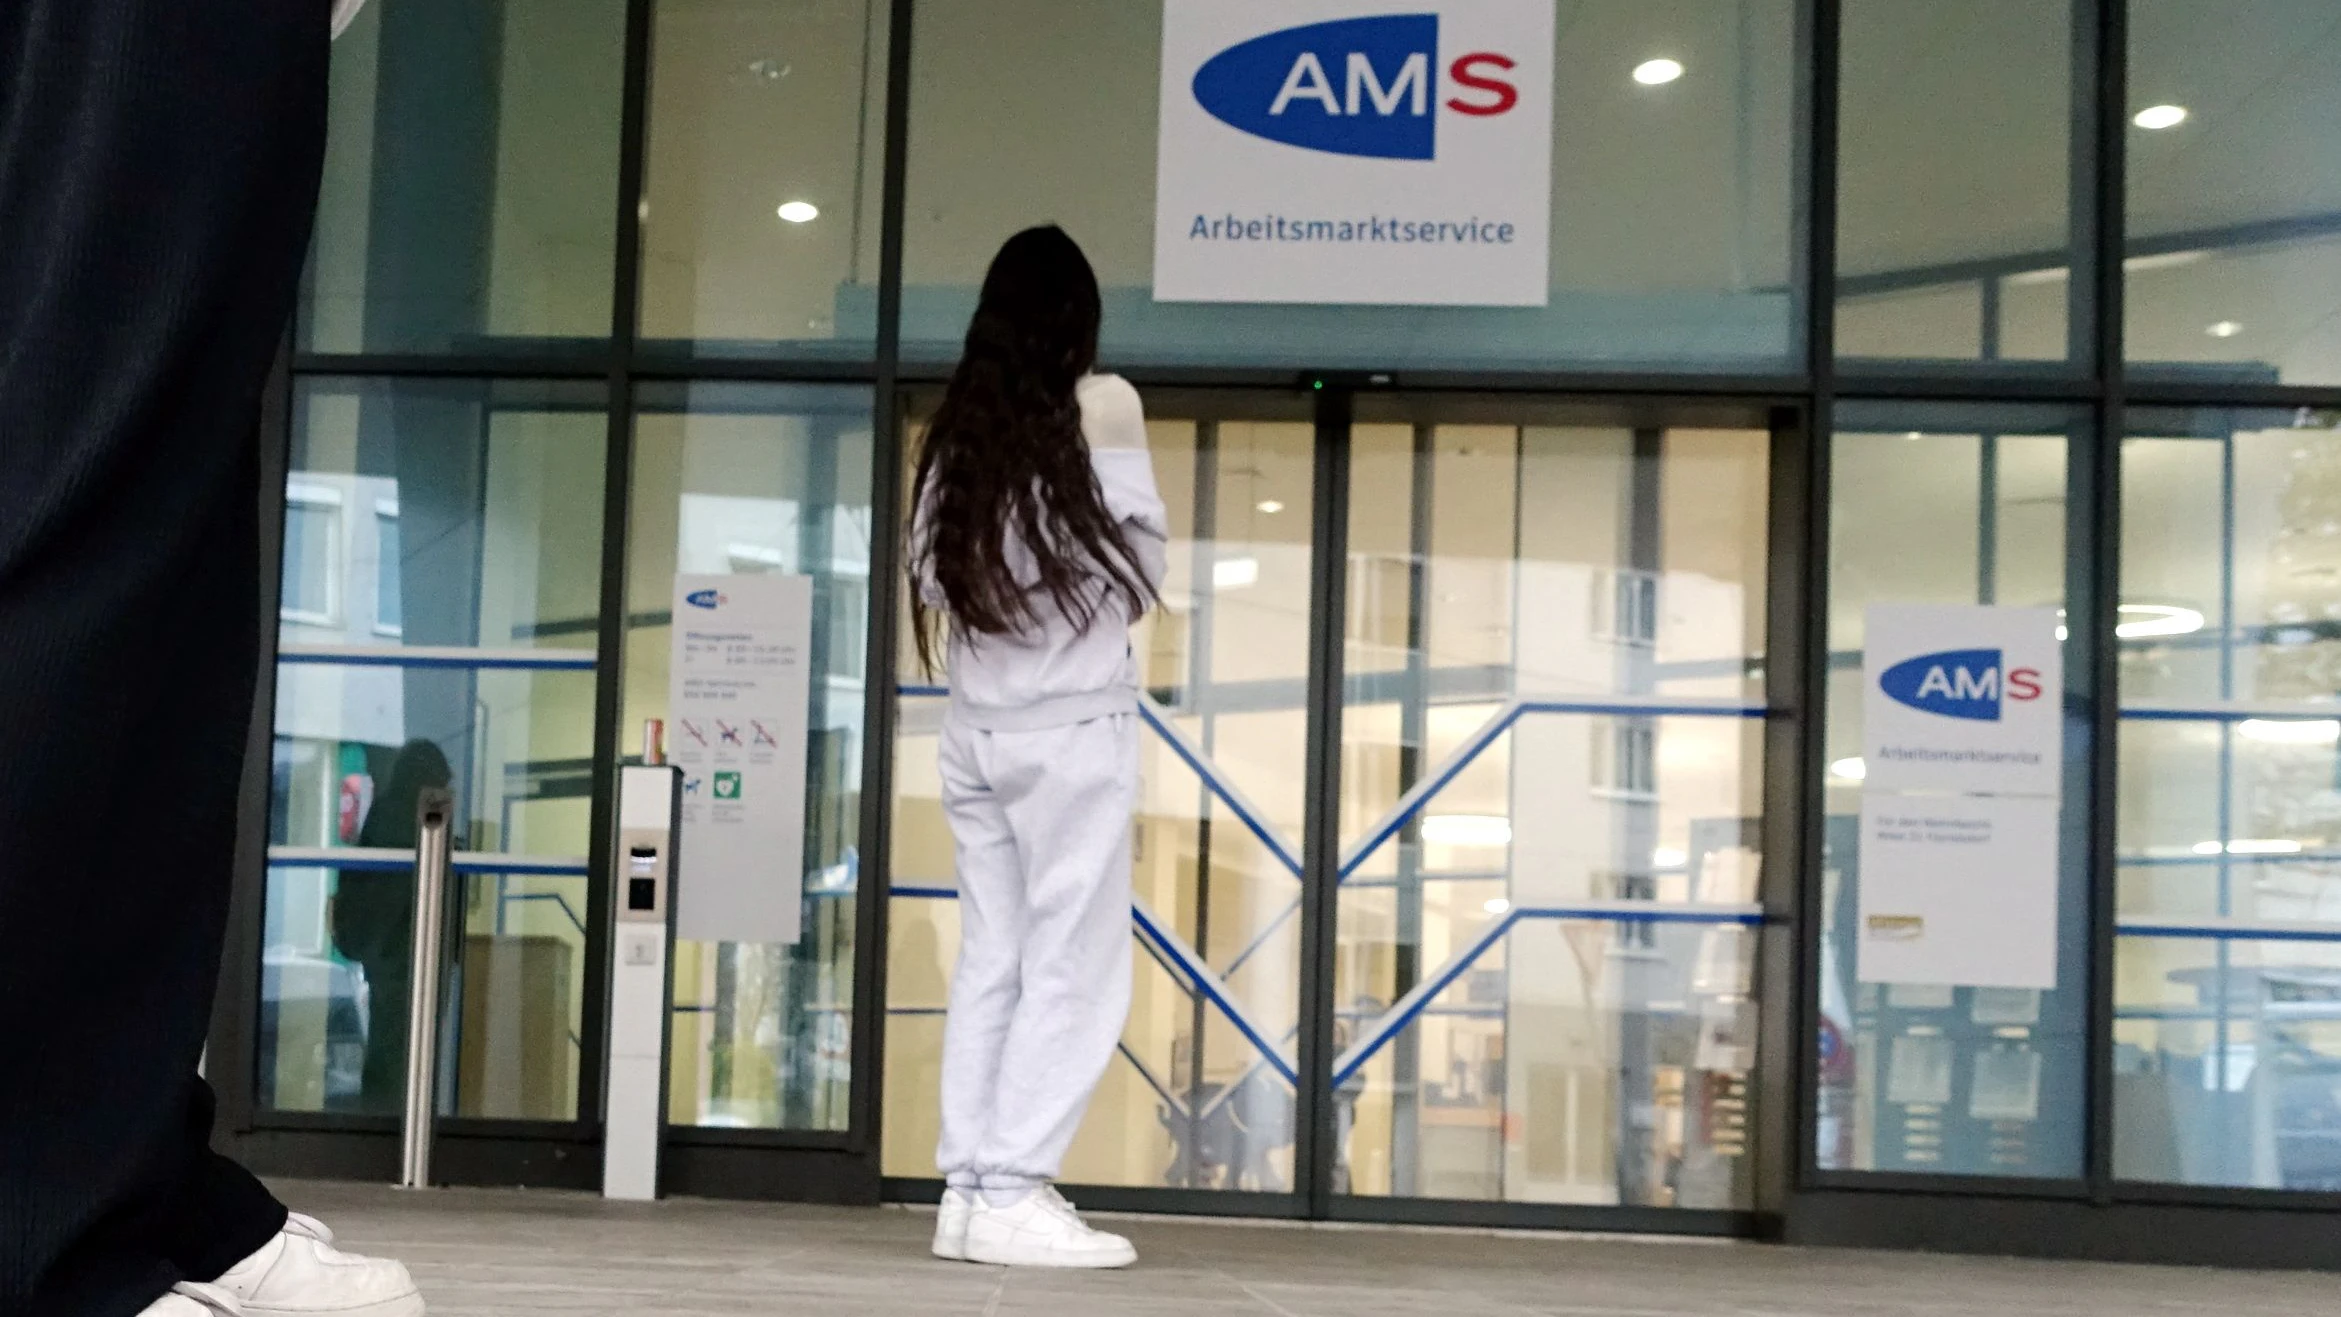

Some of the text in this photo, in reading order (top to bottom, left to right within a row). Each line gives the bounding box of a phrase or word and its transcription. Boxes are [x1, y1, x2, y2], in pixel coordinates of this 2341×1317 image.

[1268, 52, 1519, 118] AMS
[1189, 213, 1516, 244] Arbeitsmarktservice
[1916, 664, 2043, 702] AMS
[1877, 744, 2042, 766] Arbeitsmarktservice
